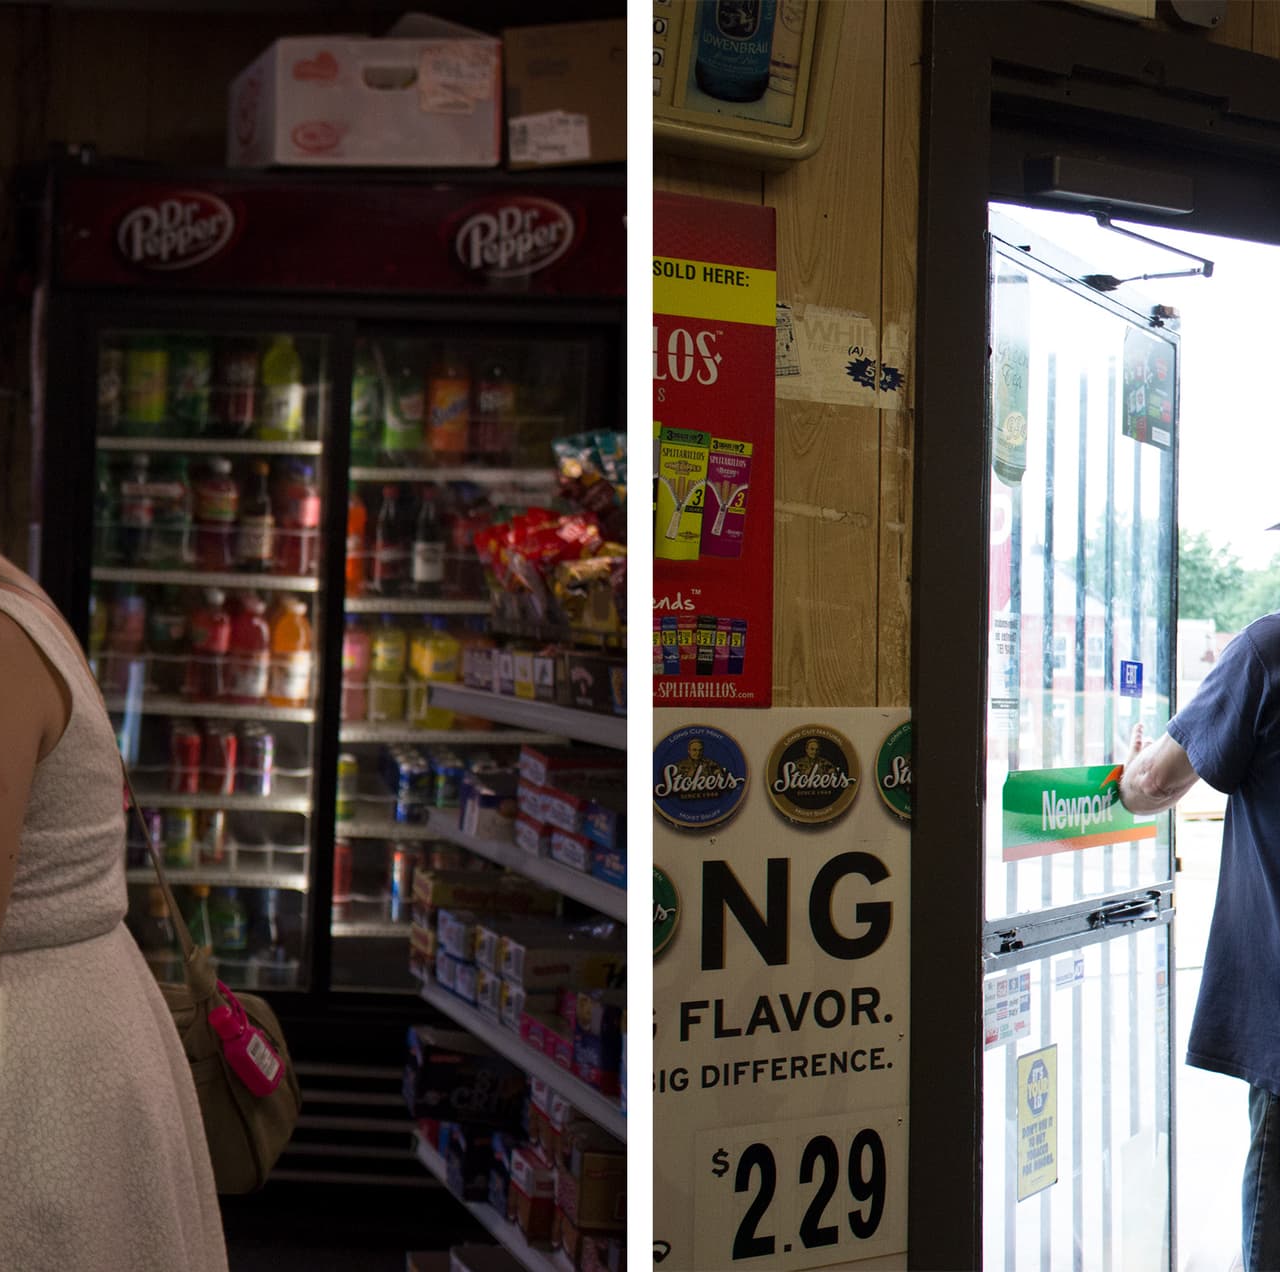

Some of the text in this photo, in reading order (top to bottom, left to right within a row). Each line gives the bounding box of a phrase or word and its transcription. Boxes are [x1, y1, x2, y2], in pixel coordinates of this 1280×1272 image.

[161, 199, 199, 229] Dr
[499, 205, 540, 234] Dr
[131, 205, 225, 263] Pepper
[467, 209, 561, 271] Pepper
[653, 260, 750, 287] SOLD HERE:
[847, 345, 864, 357] (A)
[692, 489, 703, 505] 3
[735, 491, 745, 507] 3
[655, 763, 745, 797] Stoker's
[773, 761, 856, 793] Stoker's
[1041, 786, 1114, 834] Newport
[680, 986, 893, 1042] FLAVOR.
[701, 1046, 893, 1090] DIFFERENCE.
